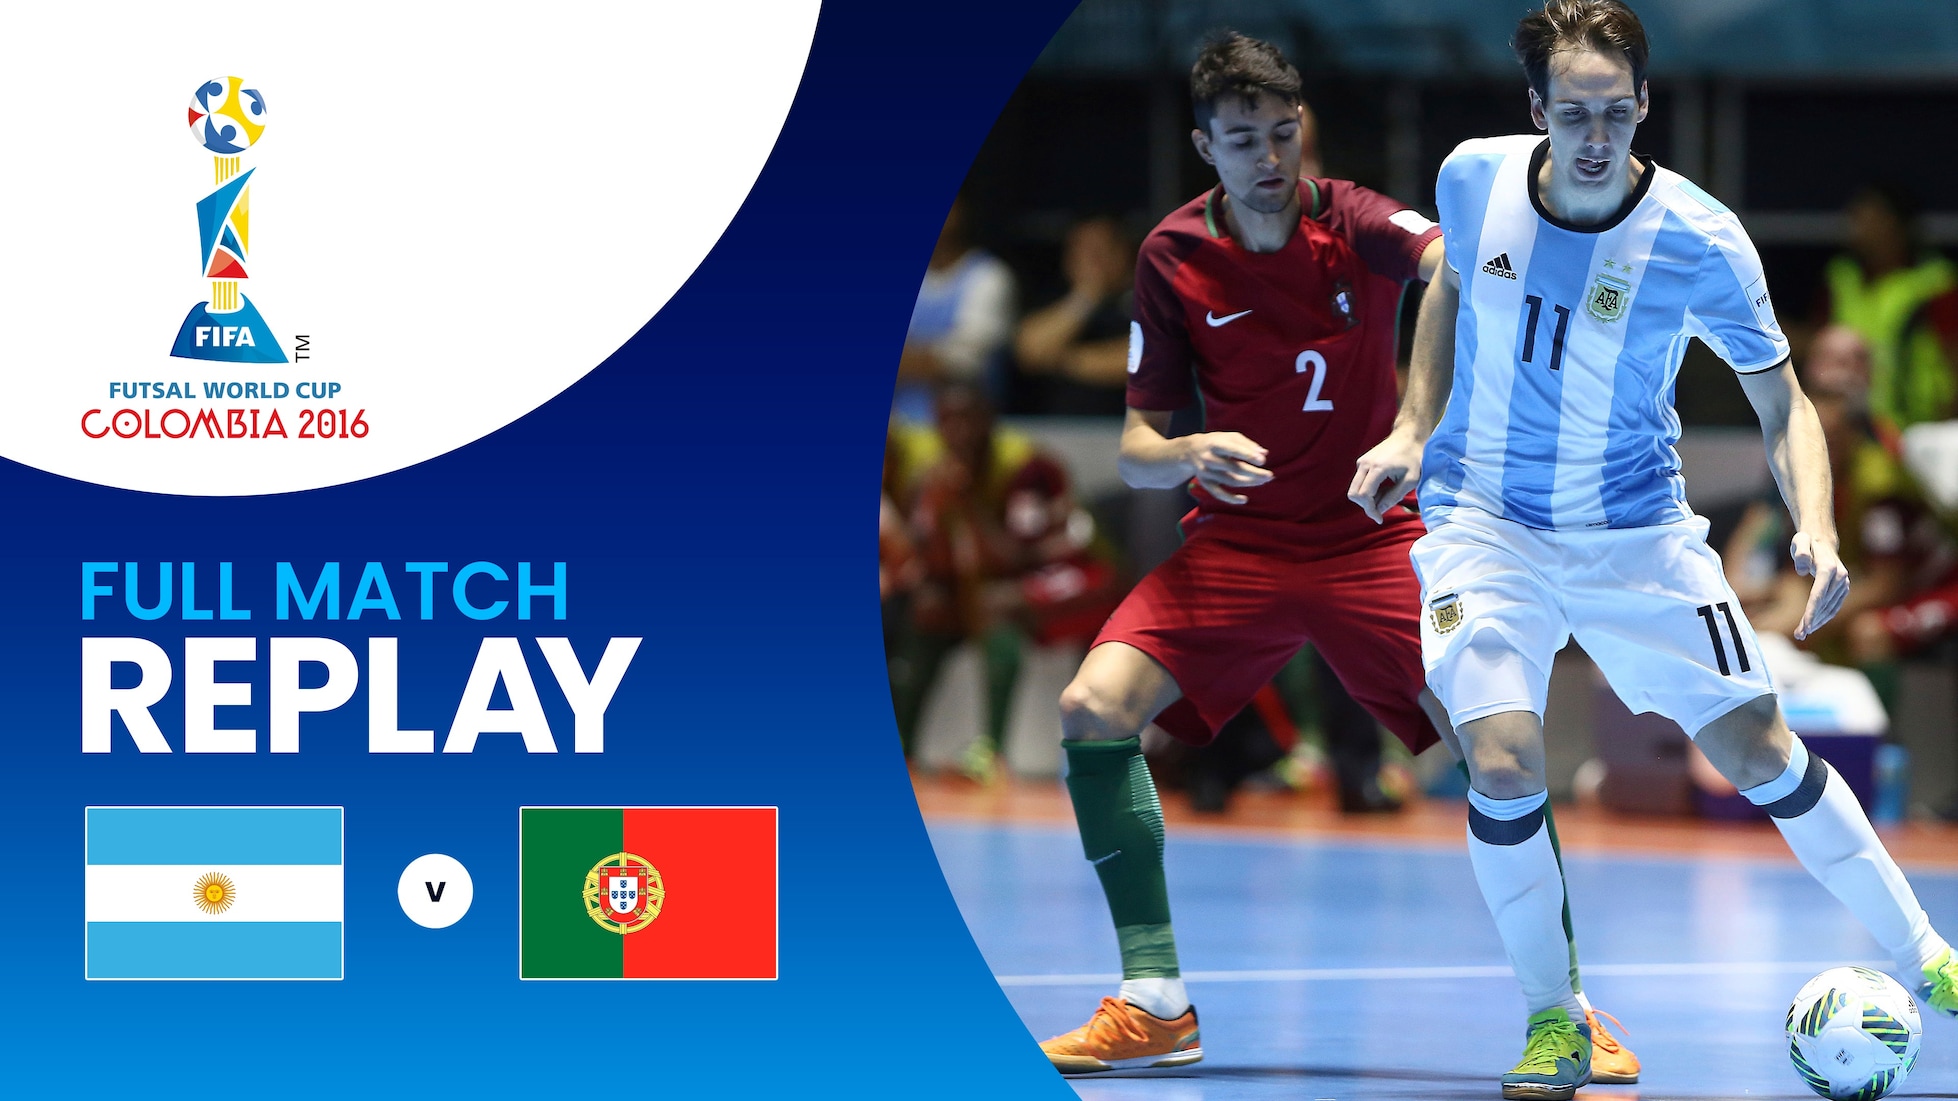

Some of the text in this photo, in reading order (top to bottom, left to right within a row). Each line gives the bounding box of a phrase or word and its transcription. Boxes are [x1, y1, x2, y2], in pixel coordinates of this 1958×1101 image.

[1482, 264, 1517, 280] adidas
[1755, 292, 1770, 308] FIF
[1521, 294, 1570, 371] 11
[1295, 349, 1334, 411] 2
[1697, 601, 1751, 676] 11
